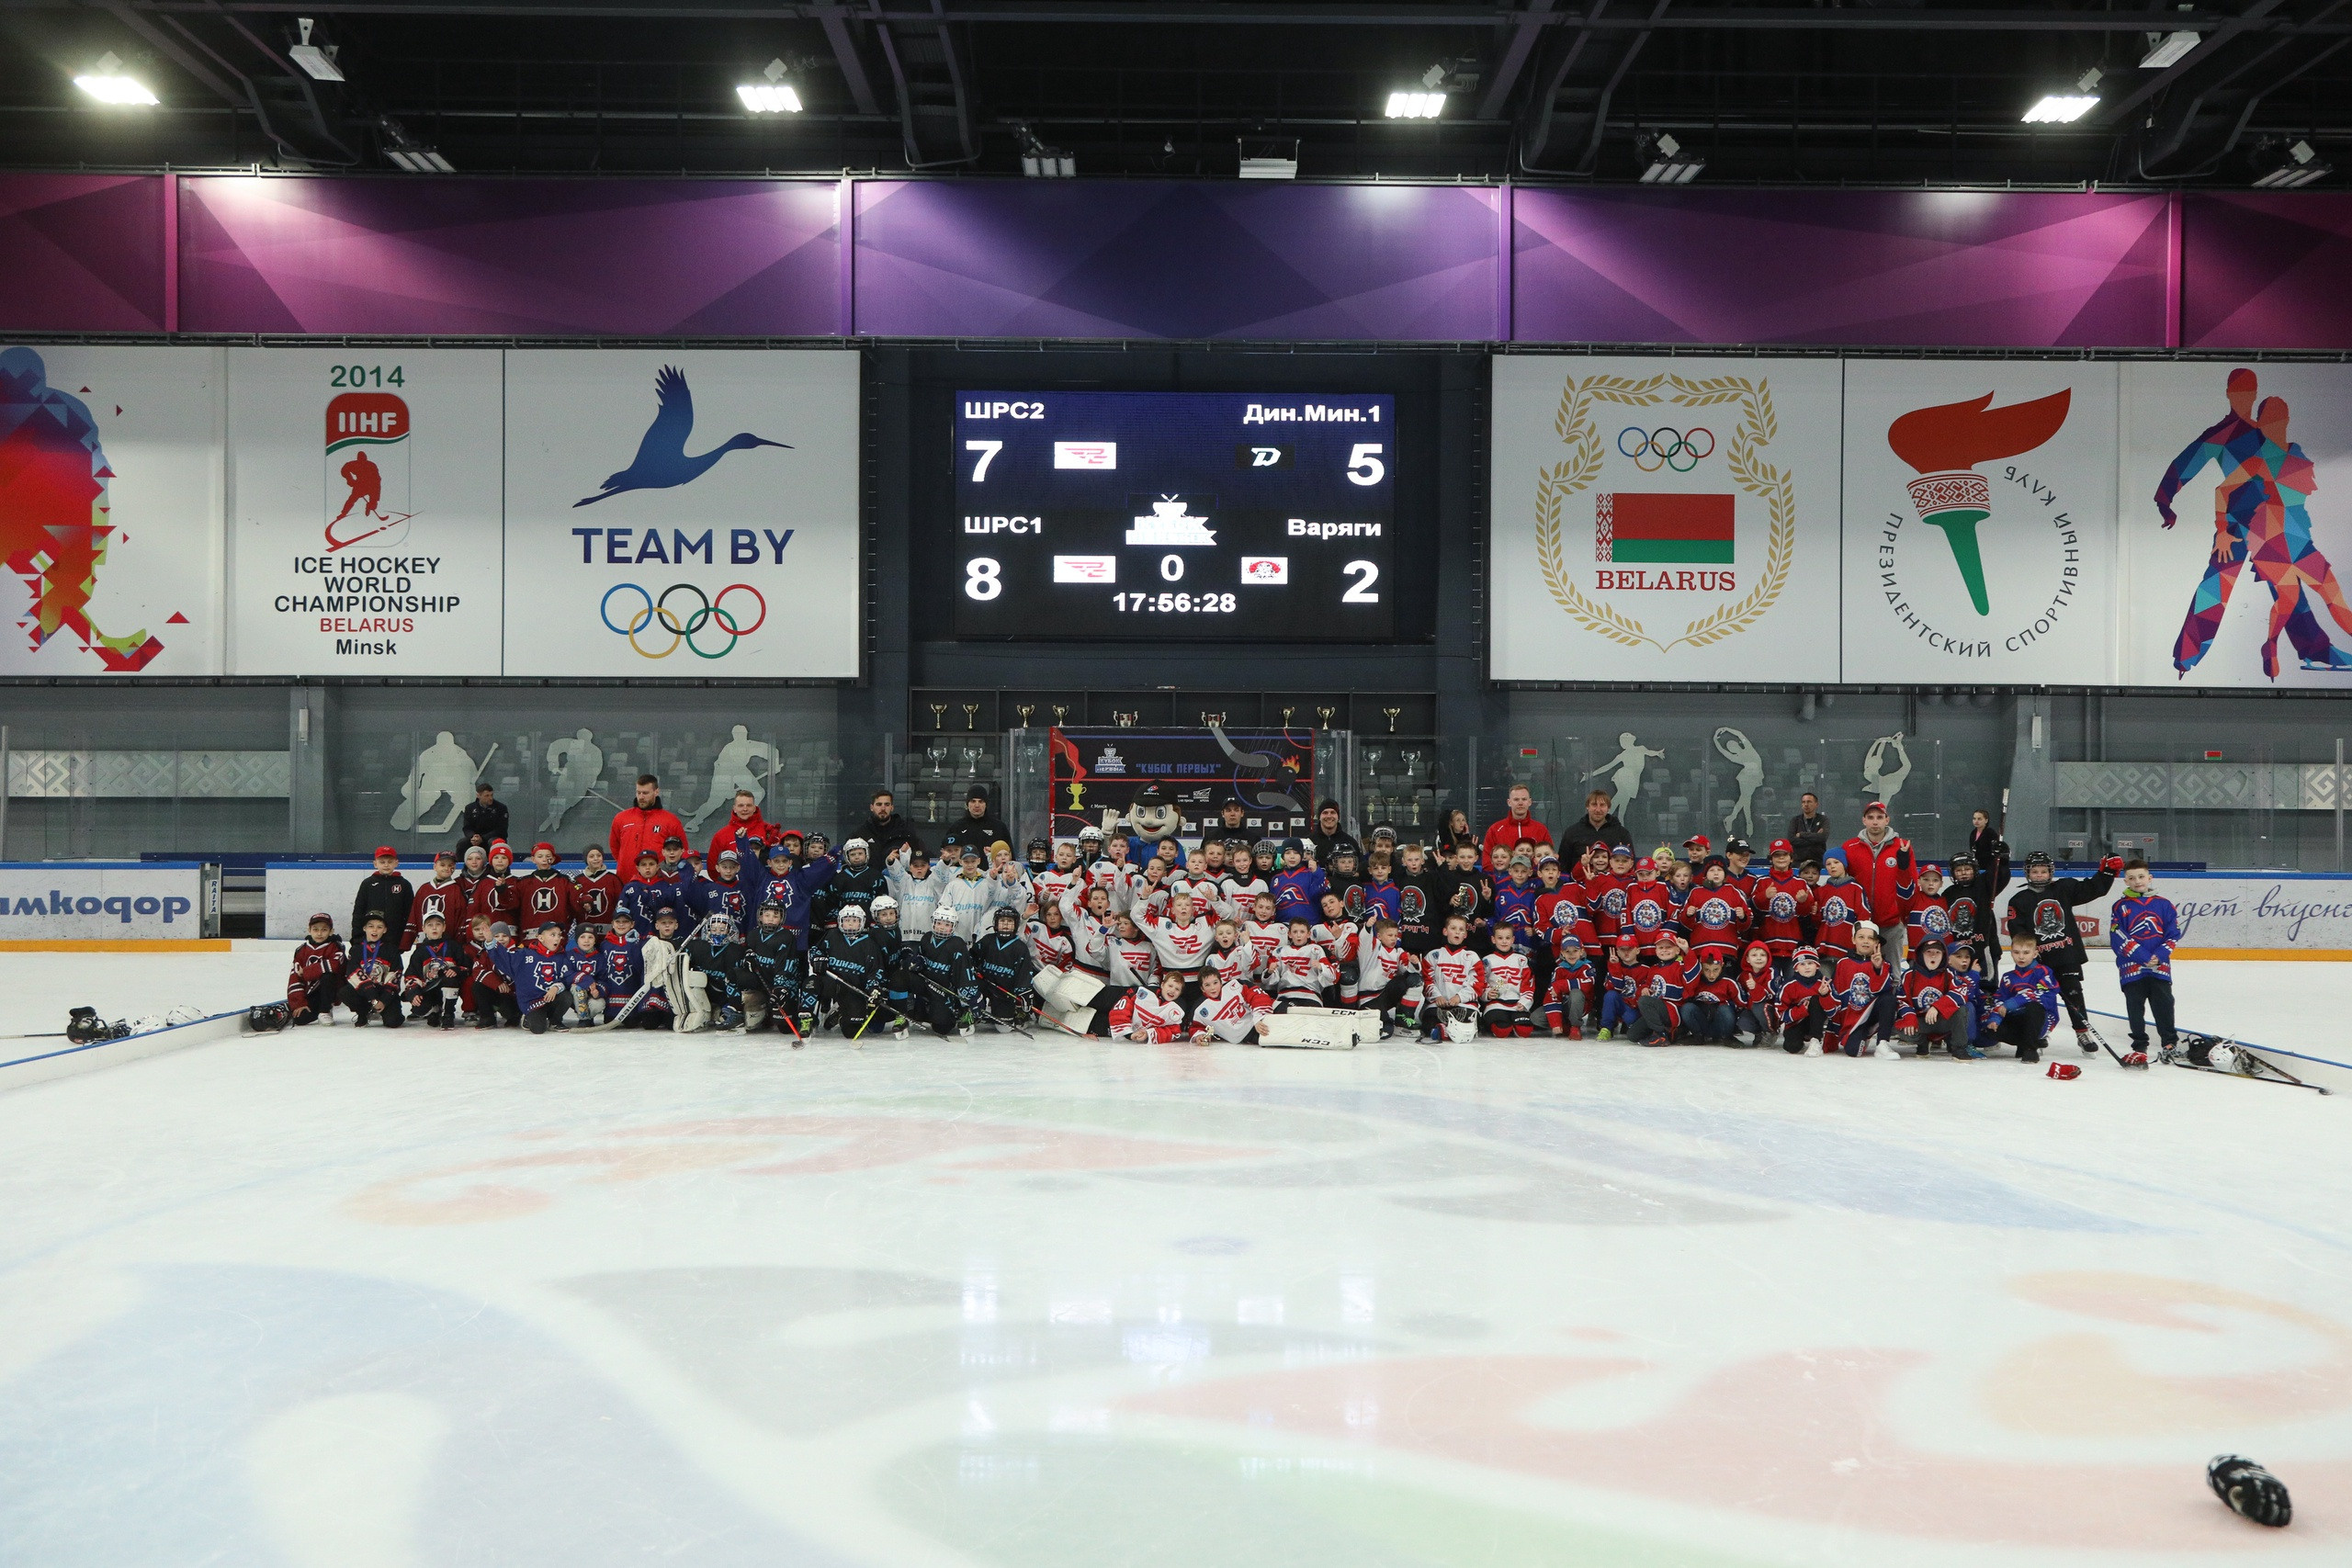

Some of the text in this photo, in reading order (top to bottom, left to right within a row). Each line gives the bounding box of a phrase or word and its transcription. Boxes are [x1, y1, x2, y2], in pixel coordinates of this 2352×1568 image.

[331, 366, 405, 388] 2014
[966, 402, 1045, 419] ШРС2
[1243, 404, 1380, 423] Дин.Мин.1
[339, 412, 397, 434] IIHF
[966, 441, 1002, 482] 7
[1346, 444, 1384, 486] 5
[966, 517, 1041, 534] ШРС1
[1288, 519, 1381, 540] Варяги
[572, 528, 795, 565] TEAM BY
[295, 558, 440, 575] ICE HOCKEY
[1160, 555, 1184, 581] 0
[1880, 466, 2078, 658] ПРЕЗИДЕНТСКИЙ СПОРТИВНЫЙ КЛУБ
[324, 578, 411, 593] WORLD
[965, 558, 1002, 600] 8
[1342, 559, 1379, 603] 2
[1596, 570, 1736, 592] BELARUS
[275, 595, 460, 613] CHAMPIONSHIP
[1113, 592, 1237, 613] 17:56:28
[321, 618, 413, 633] BELARUS
[336, 639, 396, 655] Minsk
[209, 880, 218, 914] RAITA
[1301, 1038, 1331, 1046] CCM
